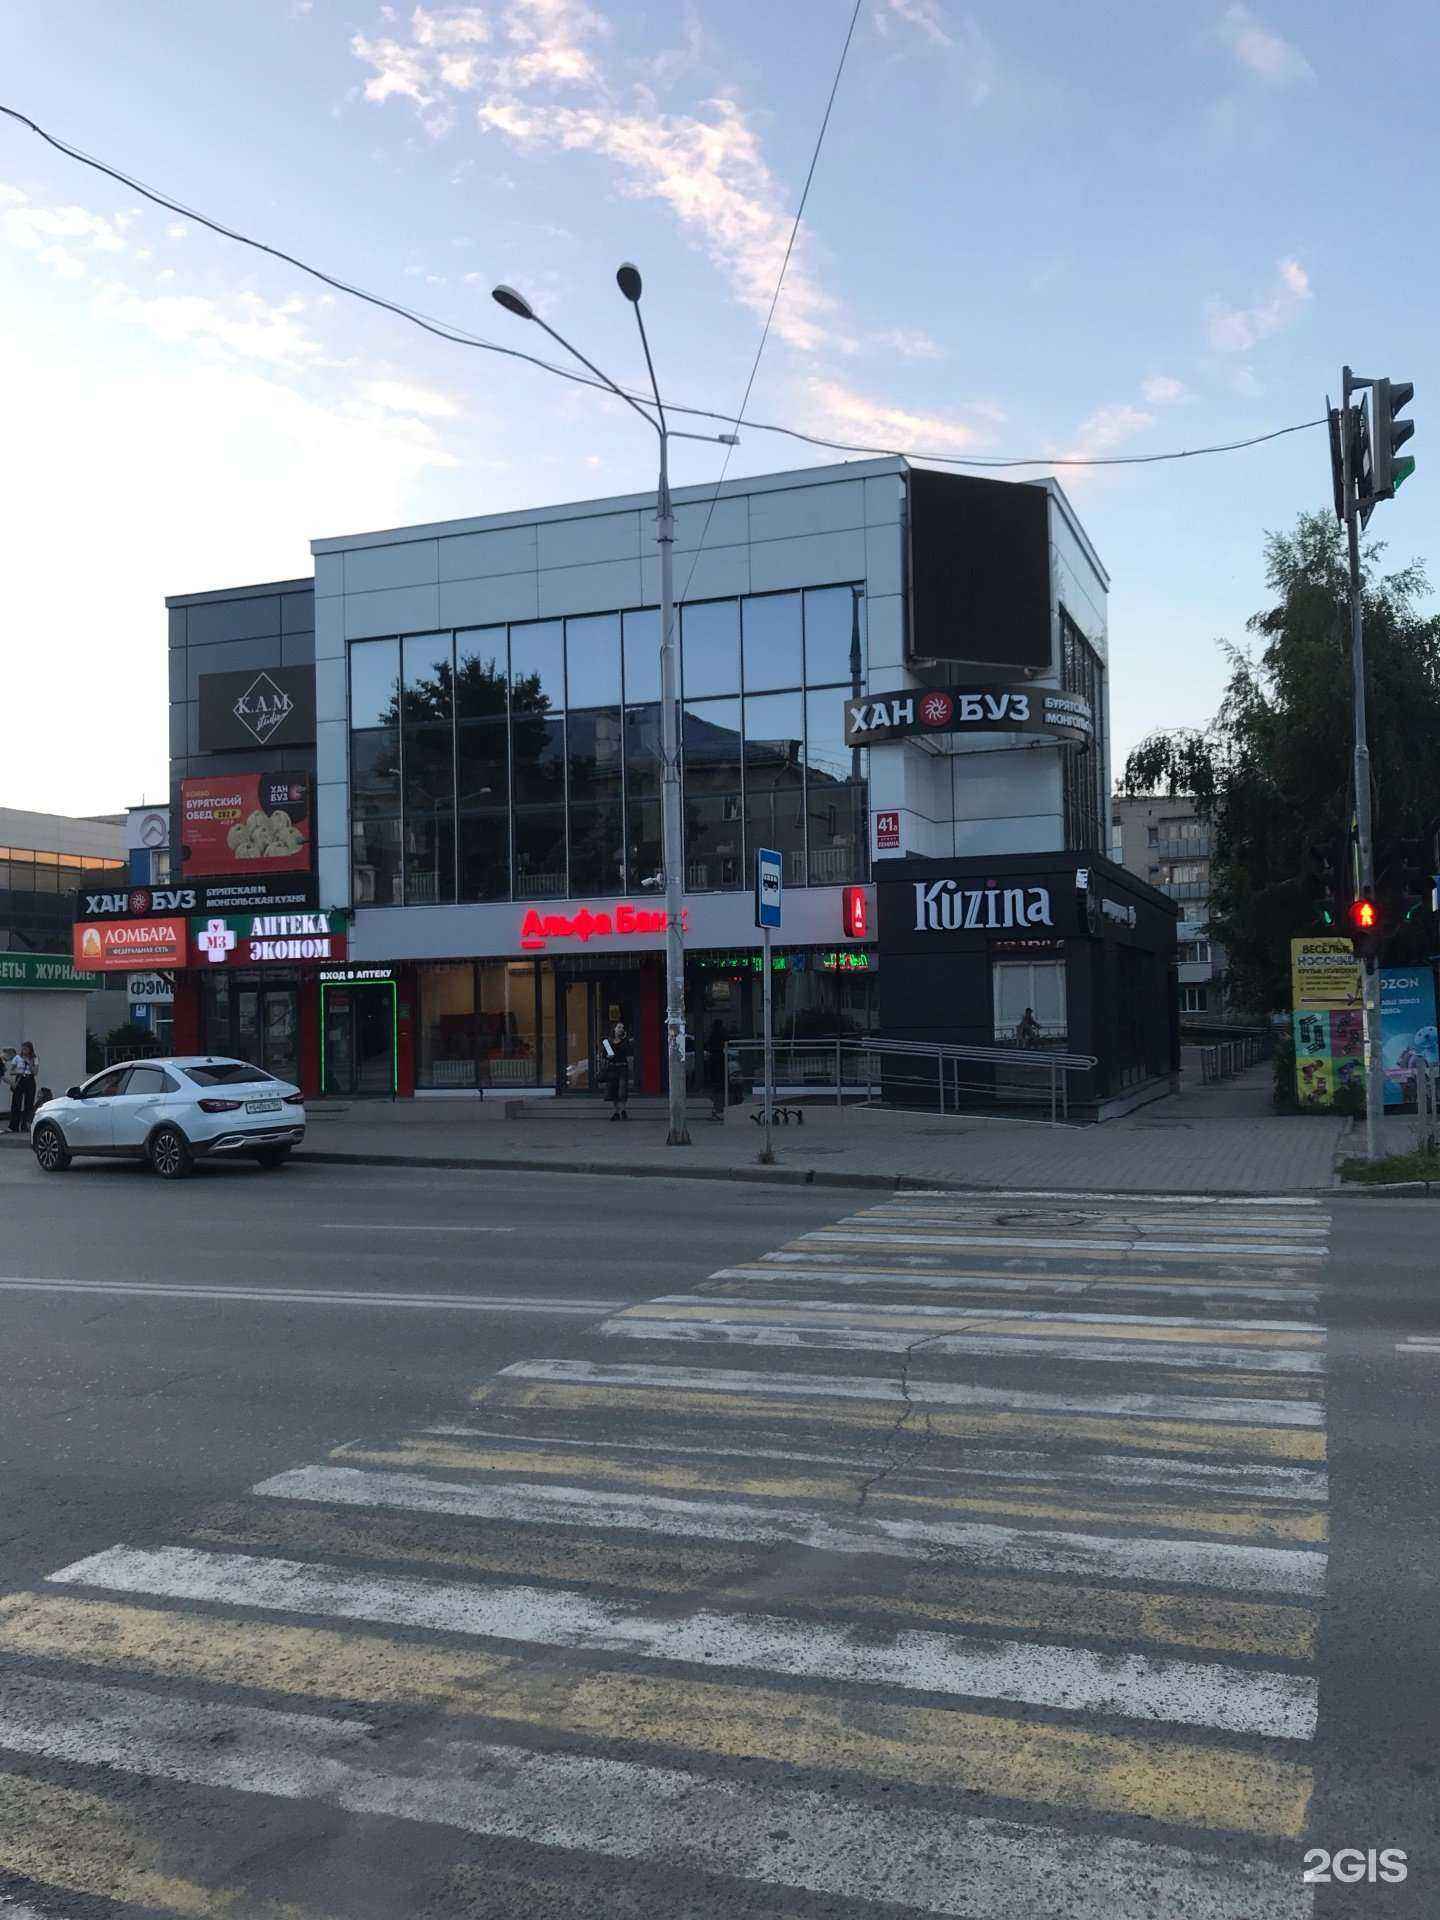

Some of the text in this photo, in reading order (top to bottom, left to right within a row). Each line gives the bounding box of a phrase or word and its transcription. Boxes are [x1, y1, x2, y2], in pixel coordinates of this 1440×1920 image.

[849, 693, 1031, 733] ХАН БУЗ
[270, 784, 288, 793] ХАН
[186, 794, 242, 809] БУРЯТСКИЙ
[270, 793, 288, 801] БУЗ
[186, 810, 213, 821] ОБЕД
[85, 889, 197, 914] ХАН БУЗ
[206, 894, 306, 908] МОНГОЛЬСКАЯ КУХНЯ
[251, 914, 330, 936] АПТЕКА
[521, 907, 613, 943] Альфа
[104, 926, 177, 944] ЛОМБАРД
[250, 939, 331, 961] ЭКОНОМ
[320, 969, 392, 981] ВХОД В АПТЕКУ
